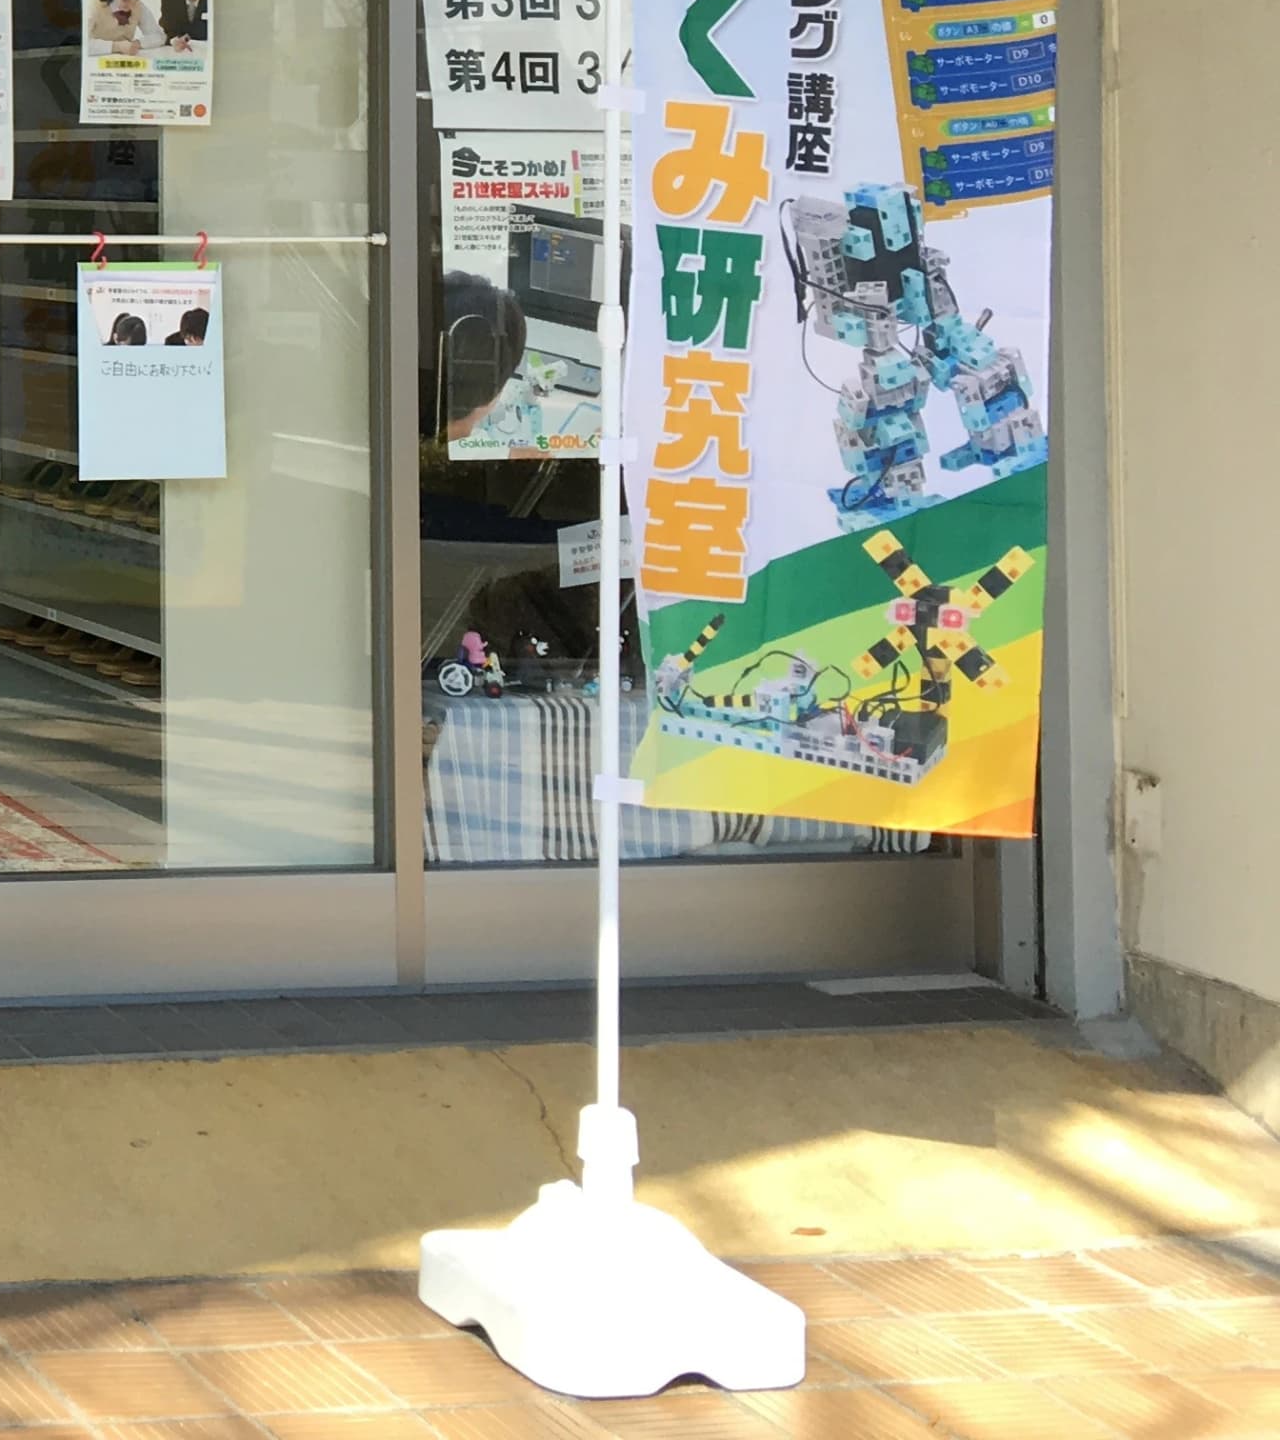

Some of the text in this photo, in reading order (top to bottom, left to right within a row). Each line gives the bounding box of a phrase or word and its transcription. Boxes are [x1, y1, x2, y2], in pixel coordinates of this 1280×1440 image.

[1012, 48, 1030, 60] D9
[445, 49, 560, 95] 第4回
[1018, 73, 1042, 87] D10
[1029, 141, 1046, 153] D9
[452, 147, 566, 177] 今こそつかめ!
[453, 182, 570, 199] 21世紀型スキル
[536, 434, 600, 450] もののしく
